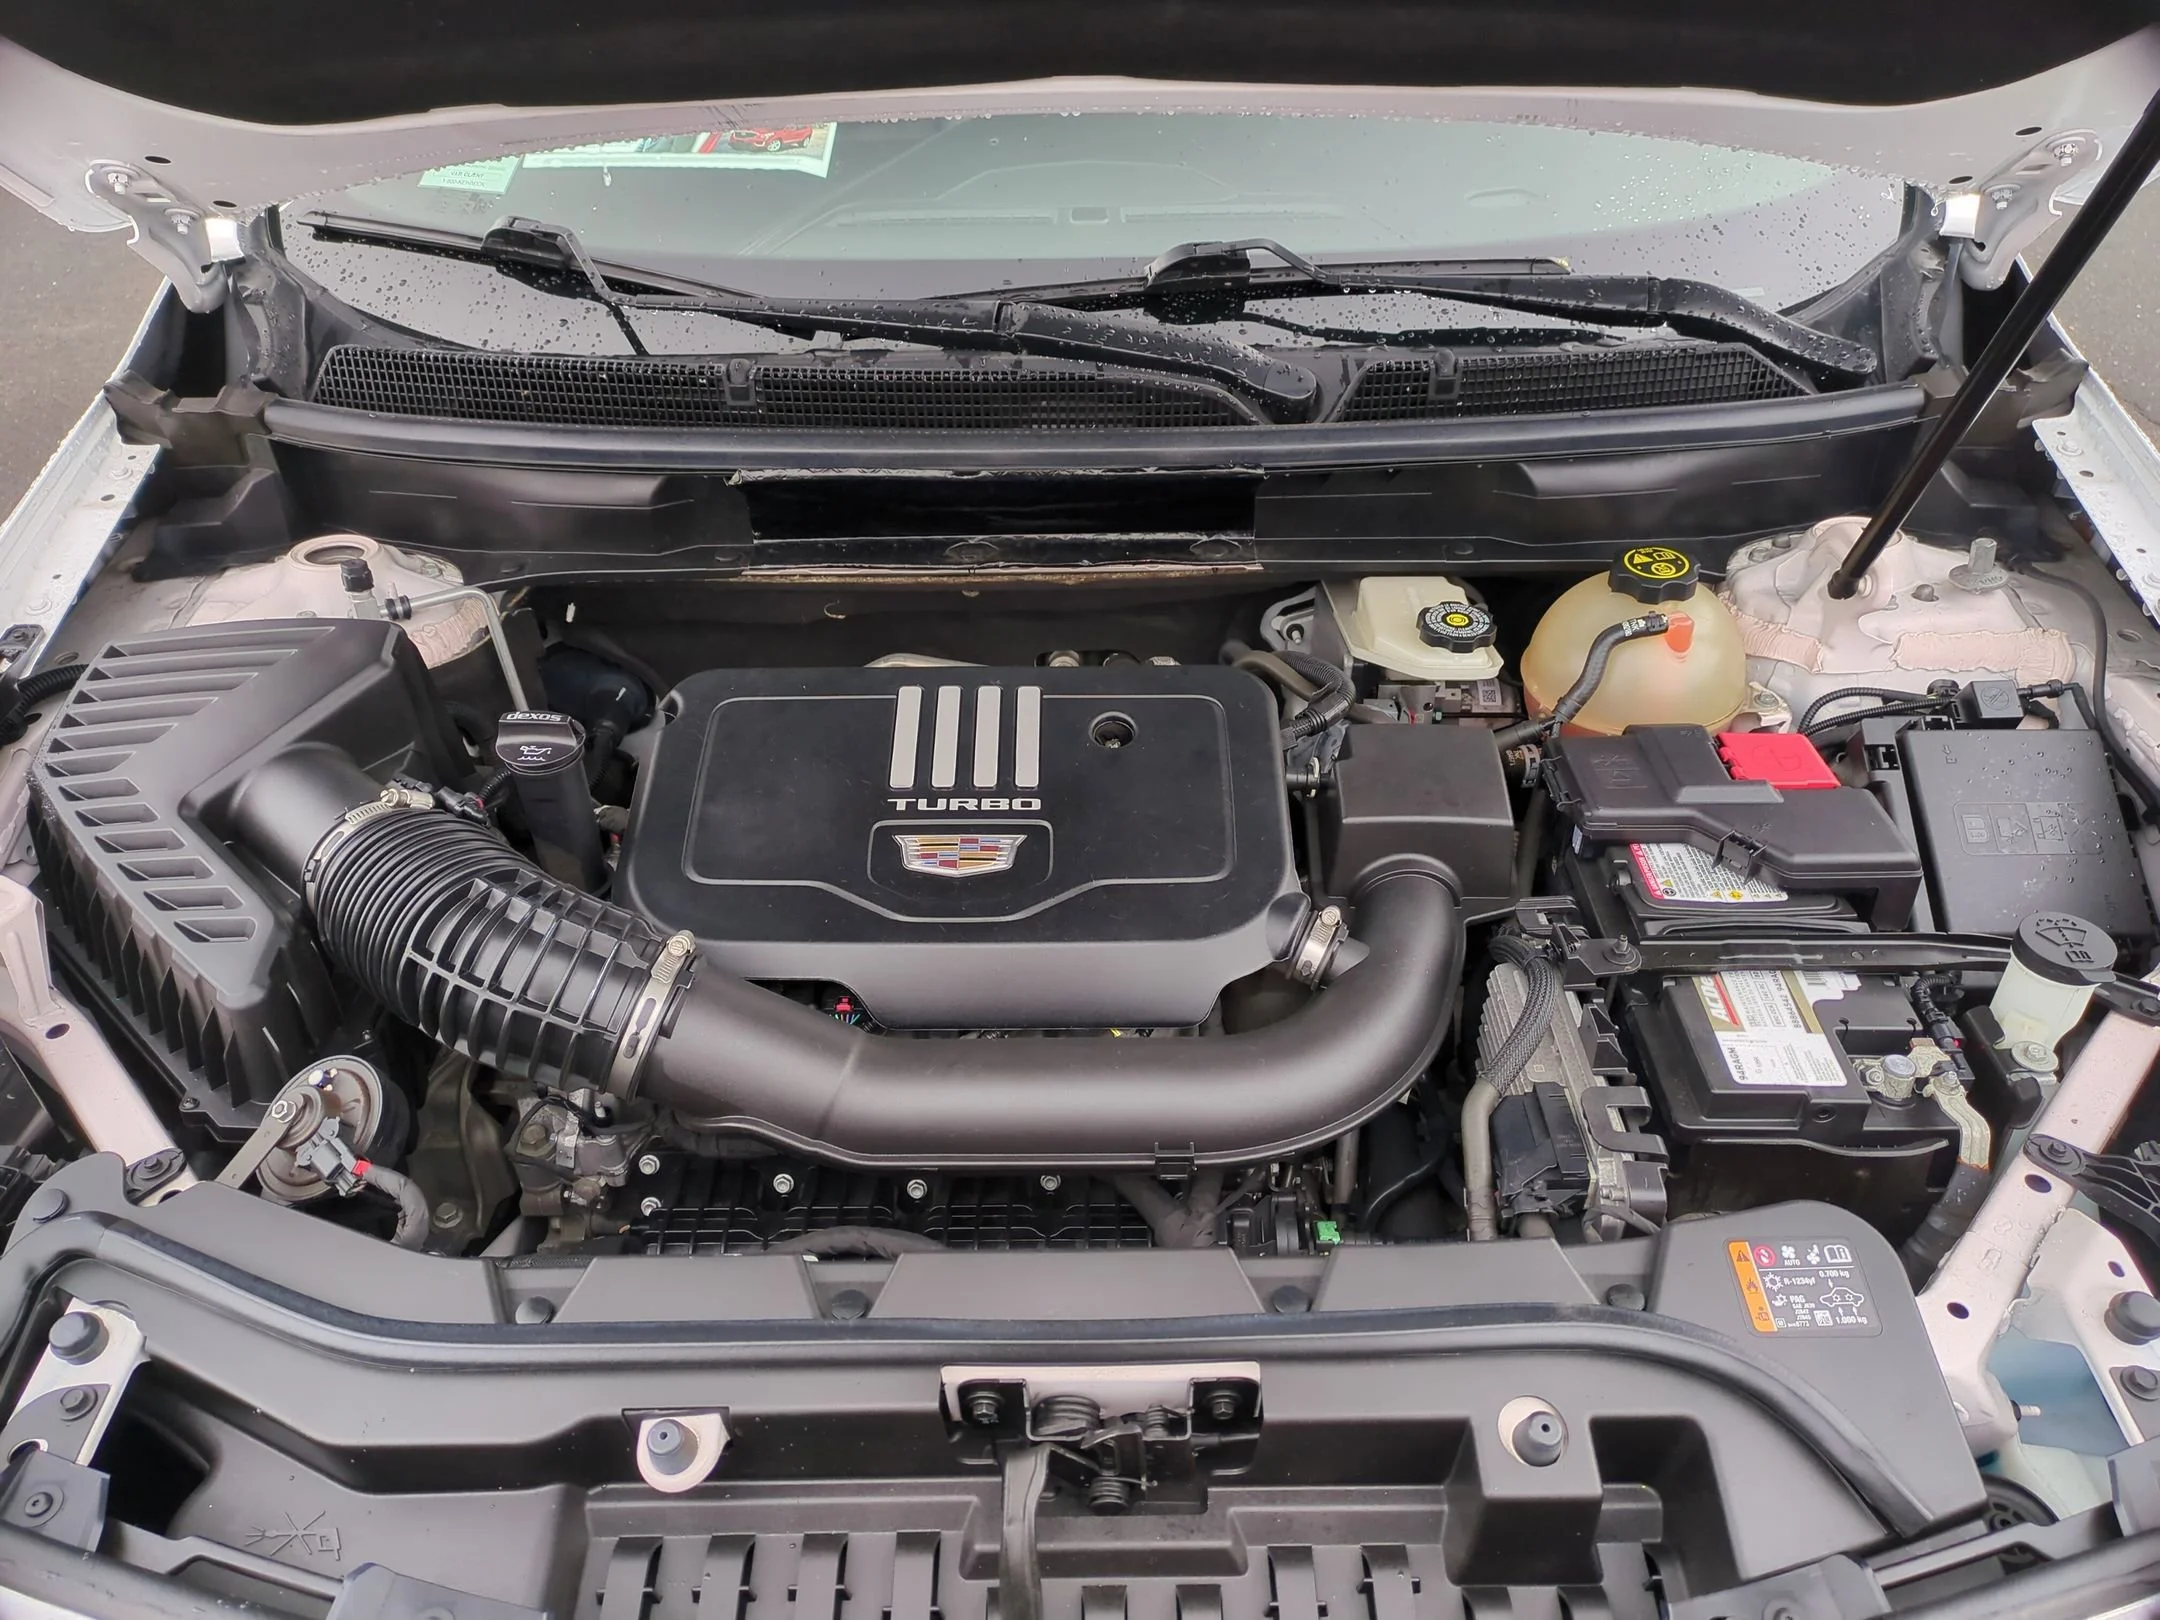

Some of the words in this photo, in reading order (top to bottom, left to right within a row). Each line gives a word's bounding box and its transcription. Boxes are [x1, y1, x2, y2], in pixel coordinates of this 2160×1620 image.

[506, 711, 563, 722] dexos
[887, 797, 1041, 811] TURBO
[1728, 1046, 1748, 1081] 94RAGM
[1818, 1270, 1839, 1278] 0.700
[1839, 1269, 1850, 1279] kg
[1789, 1294, 1806, 1304] PAG
